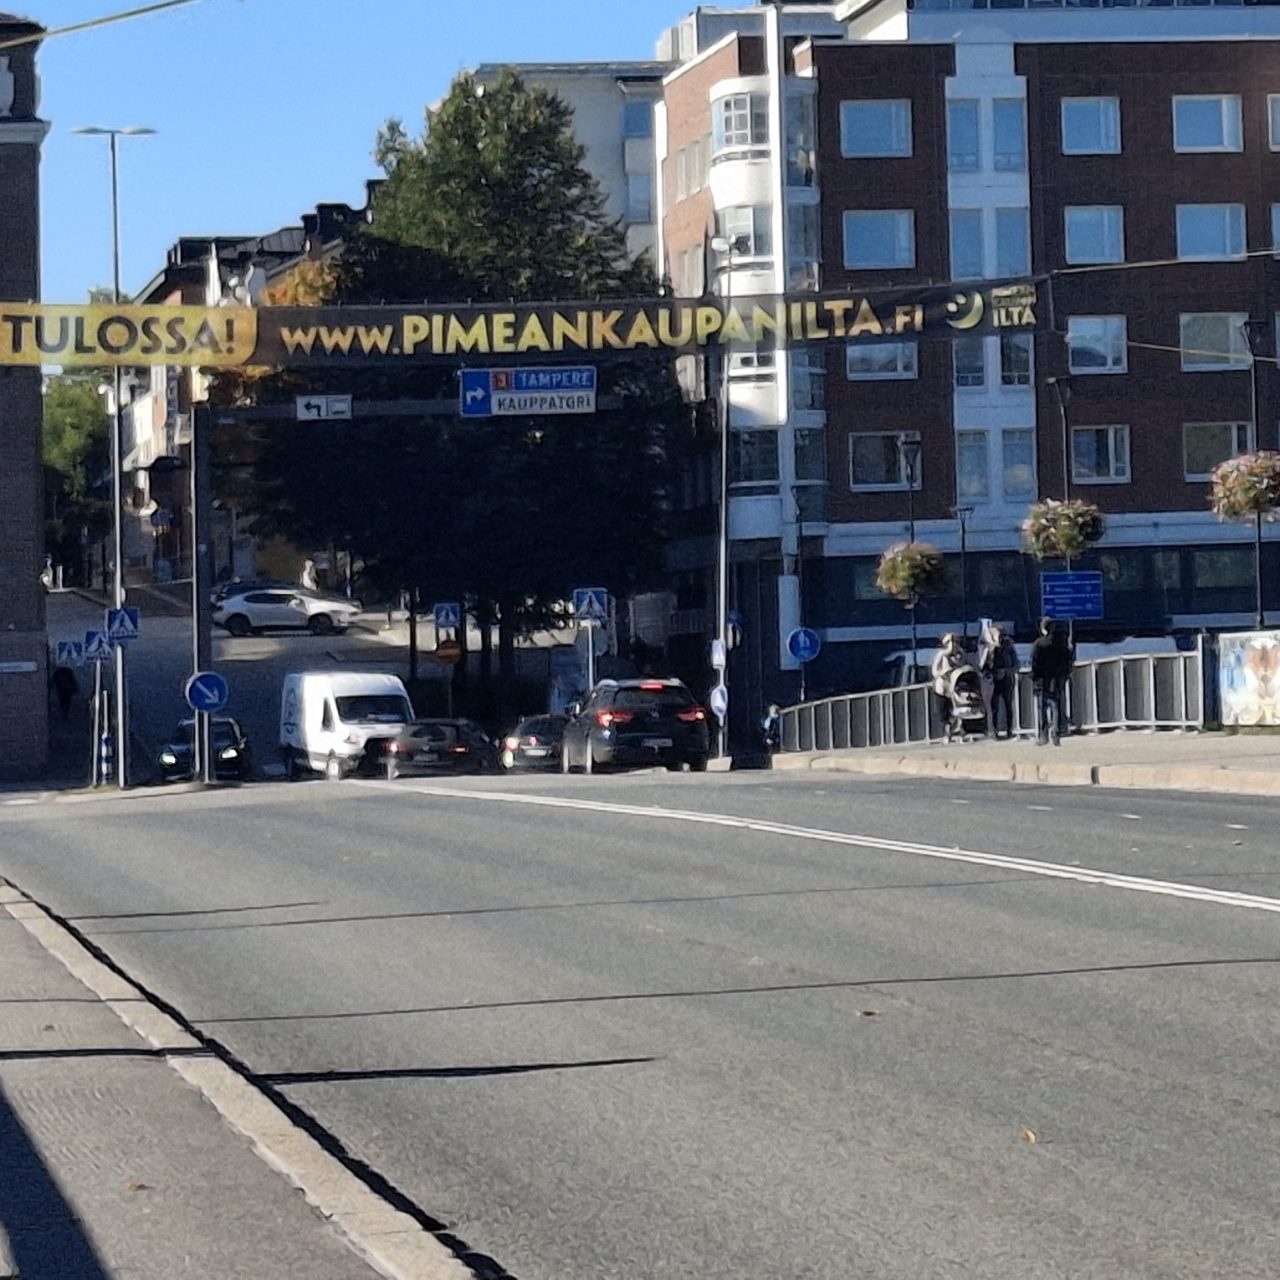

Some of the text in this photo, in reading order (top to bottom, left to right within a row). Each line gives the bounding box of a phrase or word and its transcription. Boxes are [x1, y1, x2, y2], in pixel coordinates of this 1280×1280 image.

[992, 306, 1037, 328] ILTA
[1, 315, 236, 355] TULOSSA!
[519, 371, 592, 387] TAMPERE
[497, 396, 592, 411] KAUPPATORI
